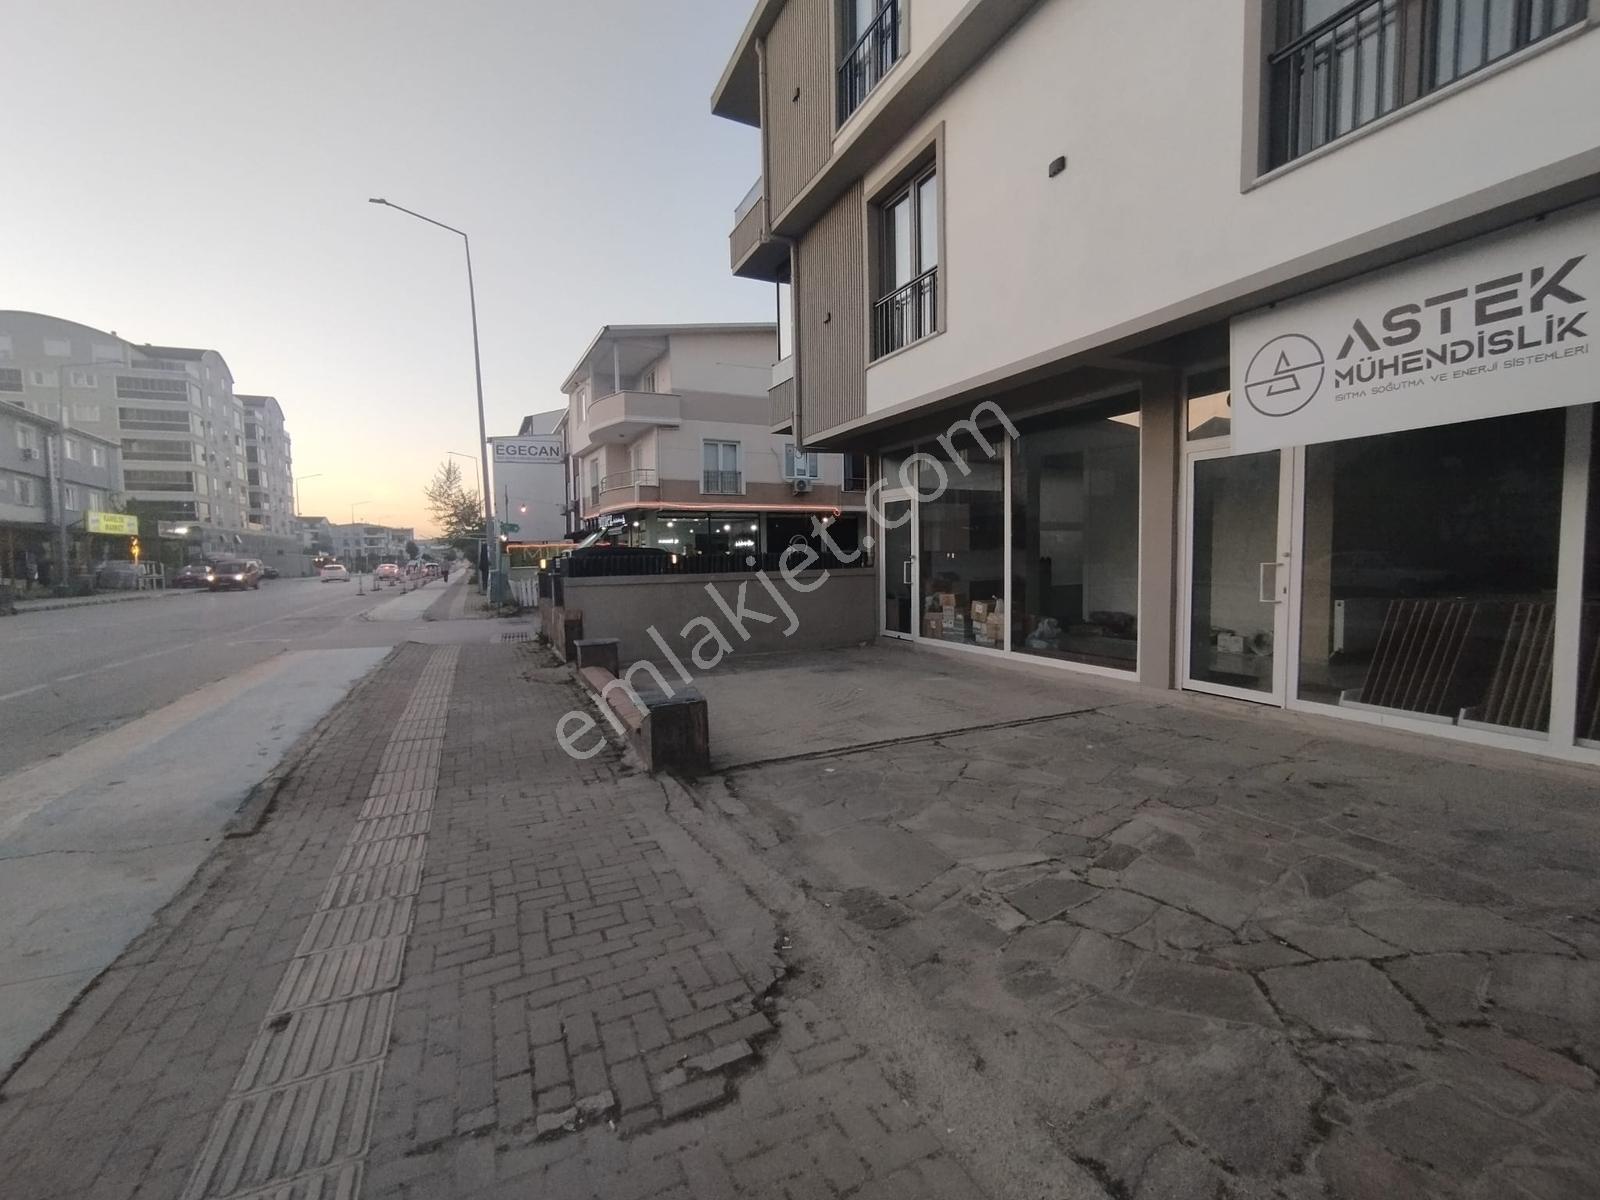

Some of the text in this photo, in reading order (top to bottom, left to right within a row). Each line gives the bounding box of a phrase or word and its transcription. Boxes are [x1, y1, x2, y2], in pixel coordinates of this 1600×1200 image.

[1336, 254, 1588, 360] ASTEK
[1334, 311, 1589, 389] MÜHENDİSLİK
[1430, 372, 1449, 382] VE
[495, 444, 560, 457] EGECAN
